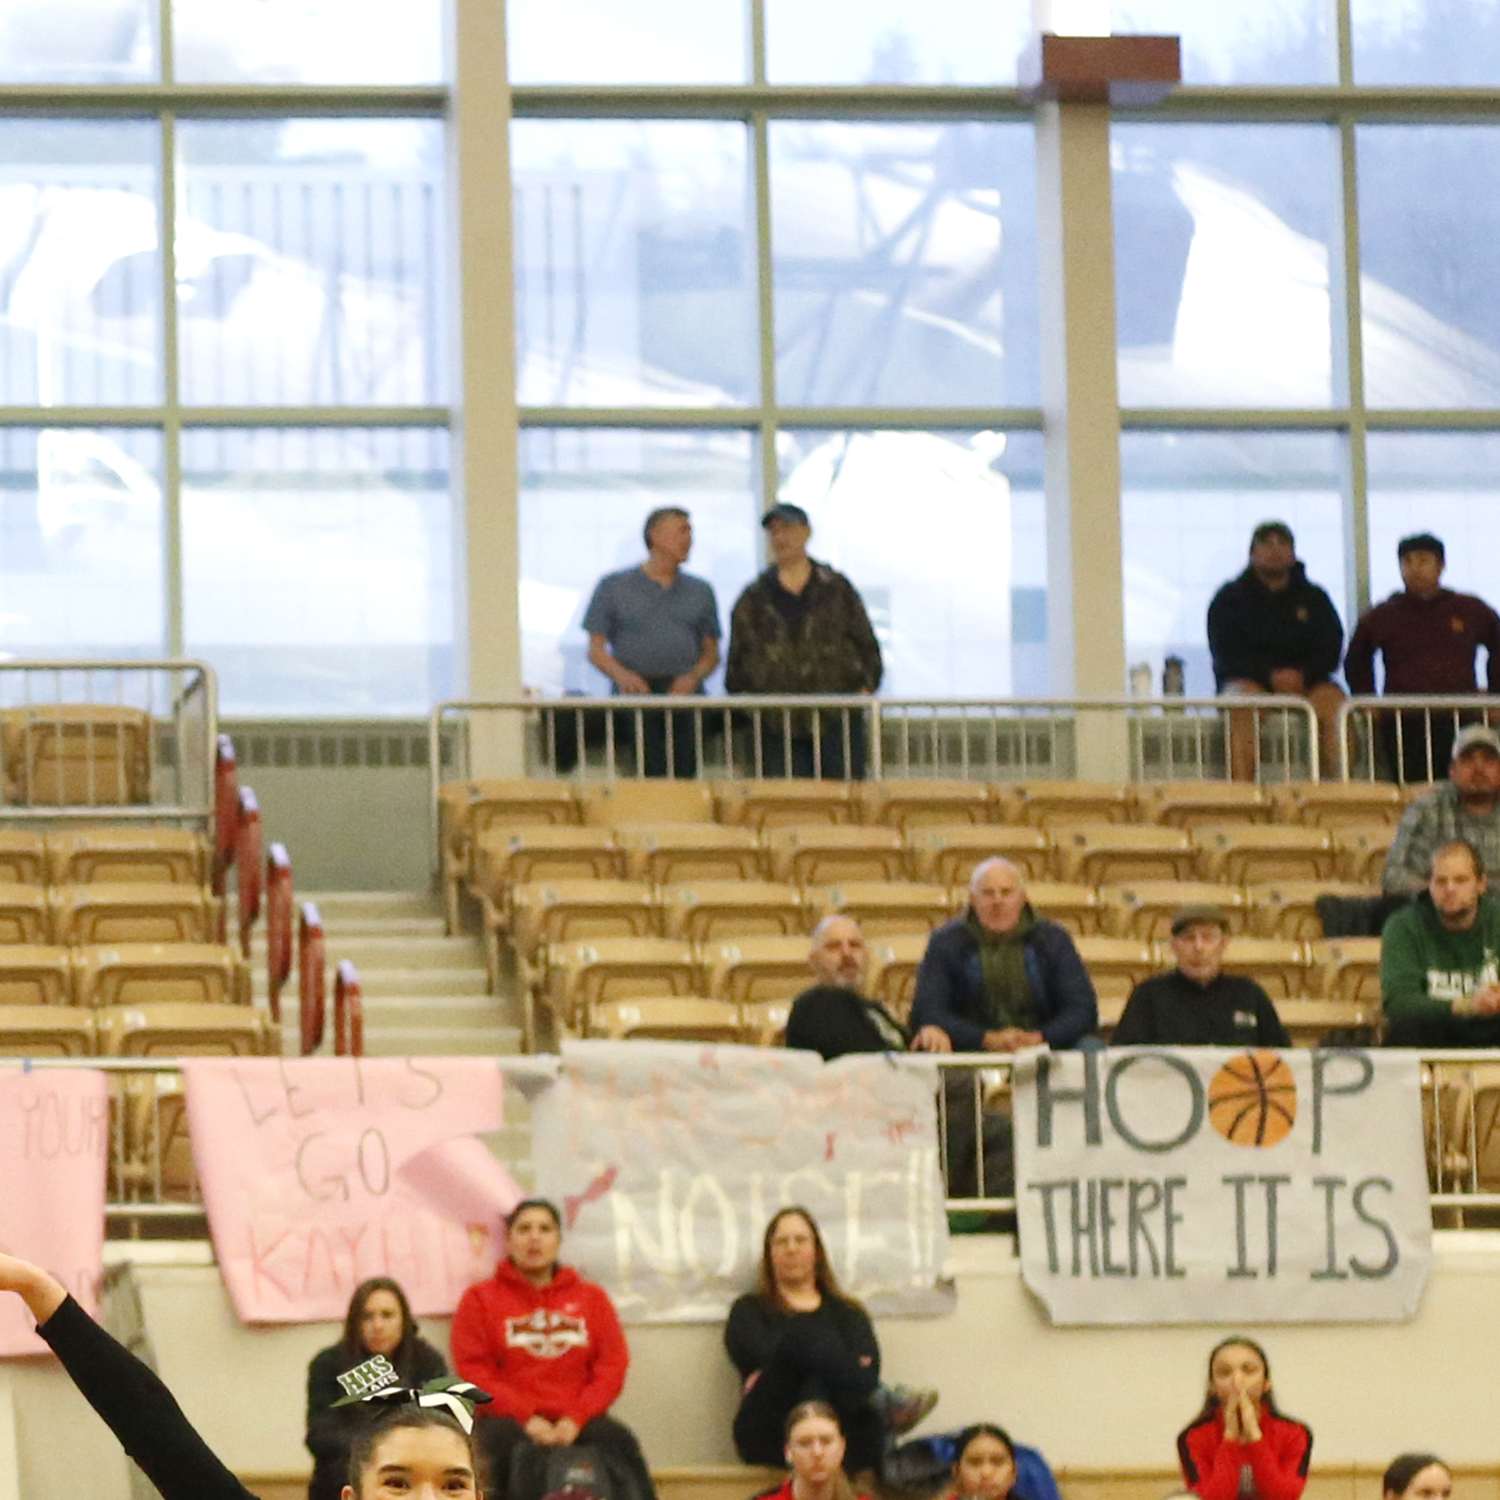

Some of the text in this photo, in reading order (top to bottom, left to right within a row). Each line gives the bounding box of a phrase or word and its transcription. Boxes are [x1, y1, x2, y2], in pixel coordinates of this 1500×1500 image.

[296, 1128, 390, 1201] GO
[1026, 1176, 1399, 1280] THERE IT IS
[336, 1354, 394, 1396] HHS
